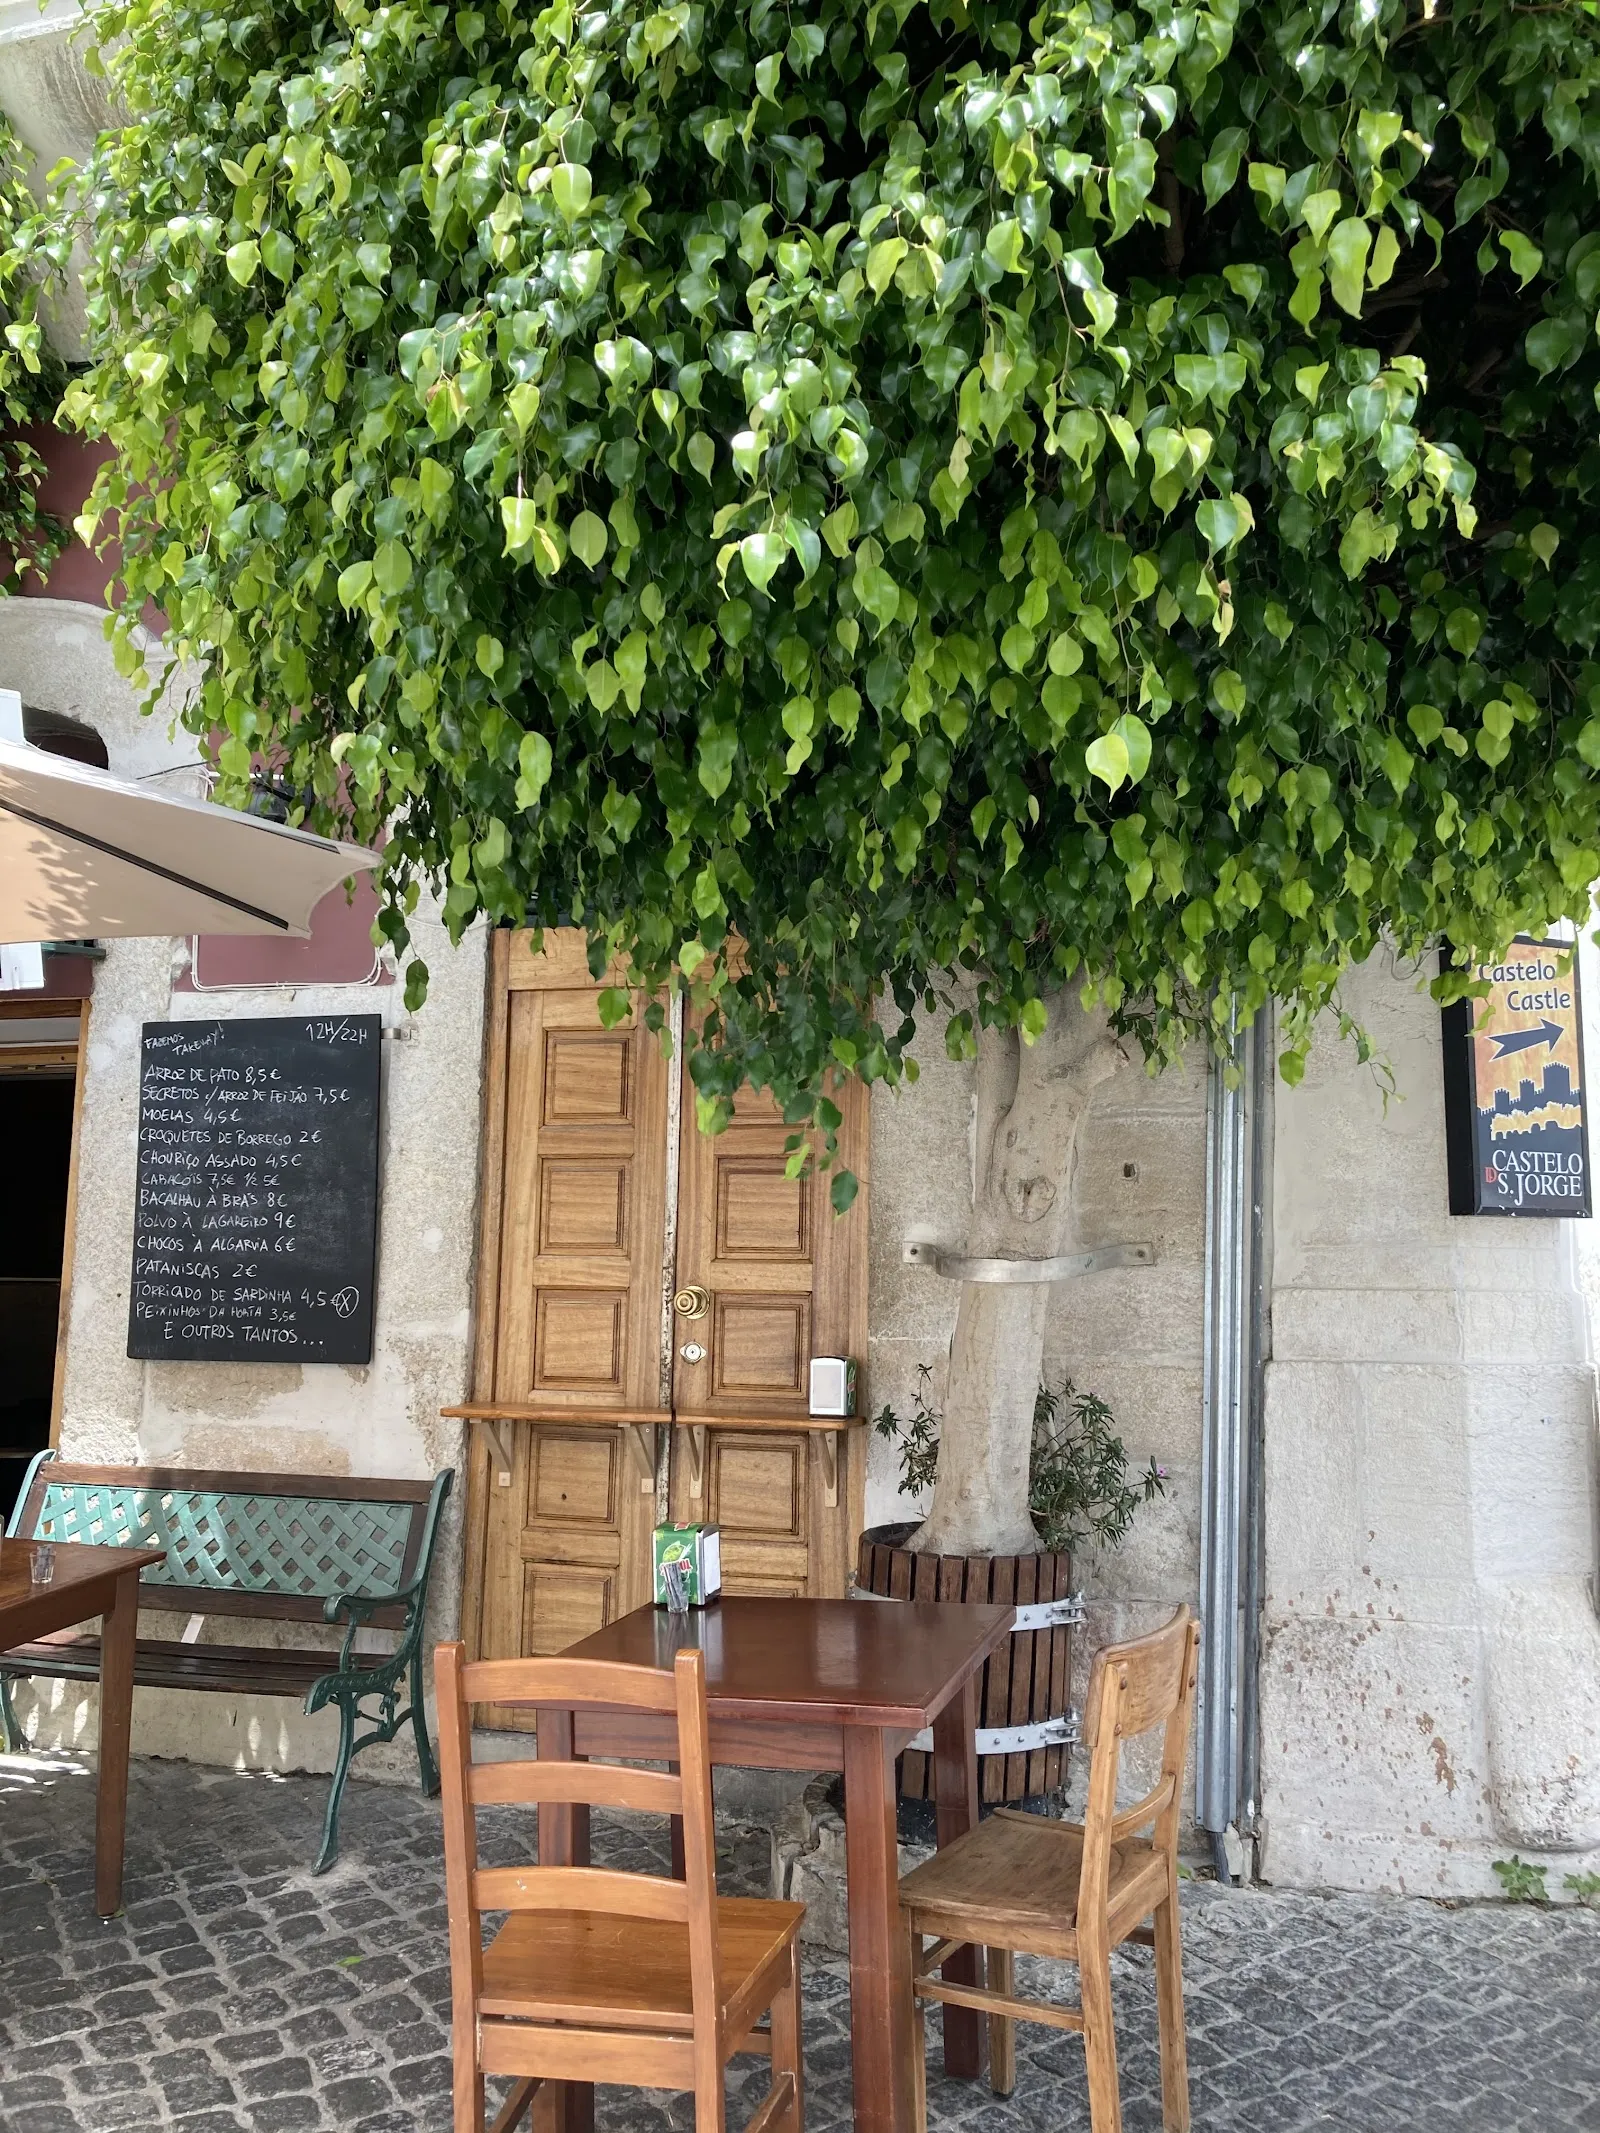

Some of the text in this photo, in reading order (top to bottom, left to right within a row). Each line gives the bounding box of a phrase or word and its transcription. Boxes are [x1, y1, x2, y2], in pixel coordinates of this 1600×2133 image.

[1507, 988, 1571, 1011] Castle
[144, 1064, 185, 1082] ARROZ
[190, 1068, 207, 1081] DE
[210, 1067, 240, 1084] PATO
[142, 1085, 200, 1101] SECRETOS
[252, 1089, 267, 1101] DE
[142, 1107, 194, 1124] MOELAS
[140, 1127, 211, 1145] CROQUETES
[218, 1132, 233, 1144] DE
[236, 1130, 292, 1146] BORREGO
[205, 1153, 257, 1168] ASSADO
[1492, 1150, 1583, 1175] CASTELO
[140, 1188, 200, 1208] BACALHAU
[138, 1212, 177, 1228] POLVO
[137, 1235, 184, 1251] CHOCOS
[211, 1288, 226, 1301] DE
[209, 1306, 225, 1318] DA
[164, 1321, 174, 1339] E
[182, 1324, 234, 1339] OUTROS
